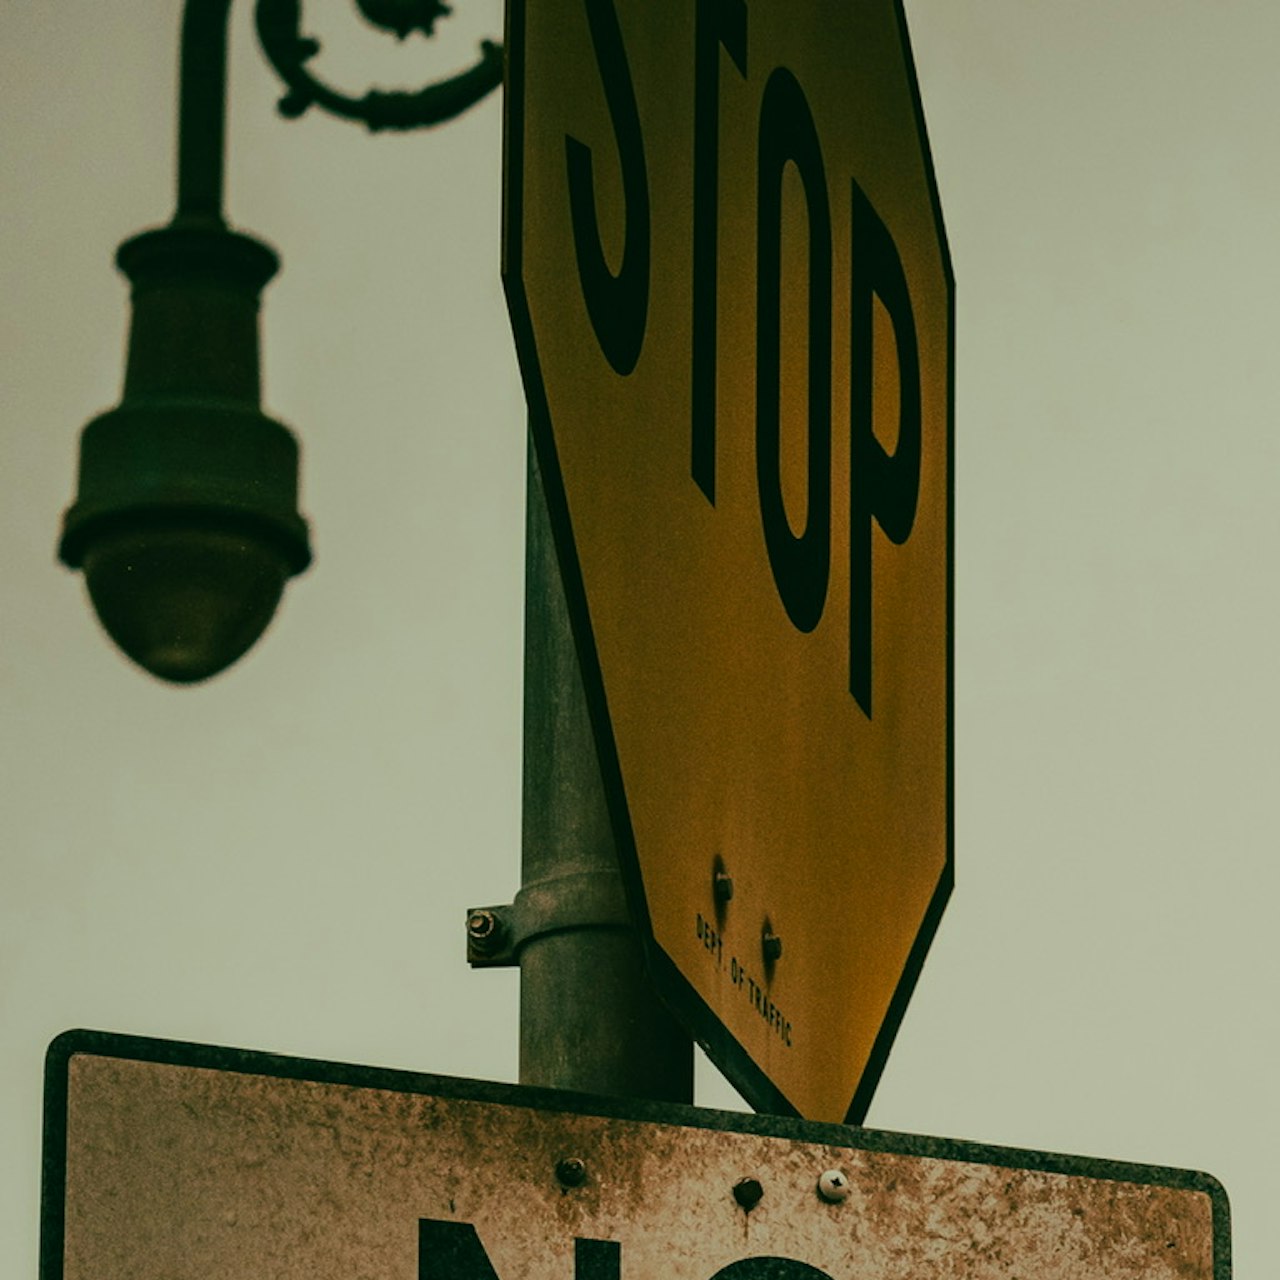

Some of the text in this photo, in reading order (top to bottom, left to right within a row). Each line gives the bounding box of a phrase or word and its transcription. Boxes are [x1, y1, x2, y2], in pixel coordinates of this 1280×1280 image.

[565, 0, 921, 721] STOP
[731, 957, 745, 990] OF
[748, 976, 792, 1047] TRAFFIC
